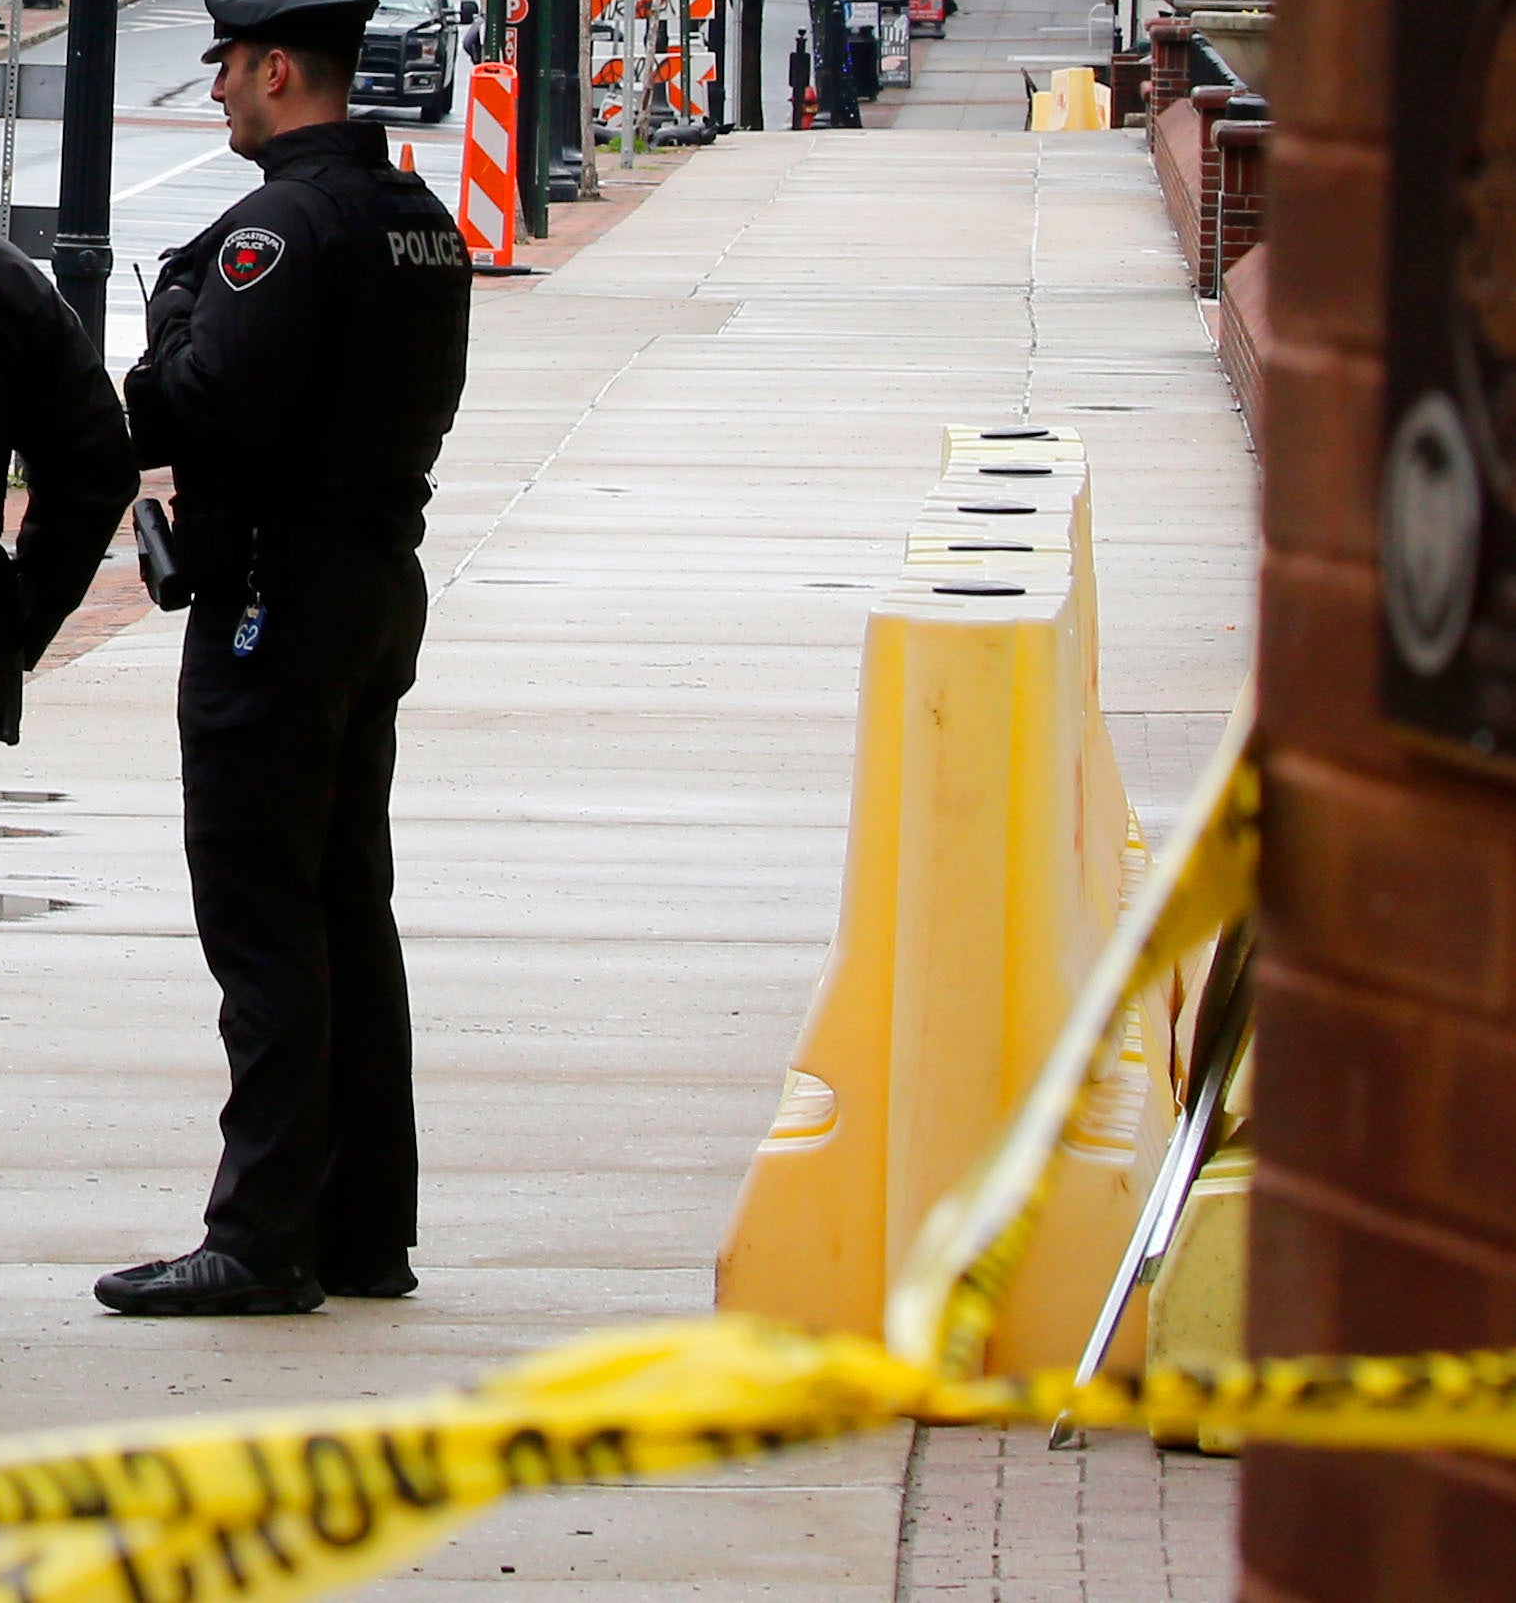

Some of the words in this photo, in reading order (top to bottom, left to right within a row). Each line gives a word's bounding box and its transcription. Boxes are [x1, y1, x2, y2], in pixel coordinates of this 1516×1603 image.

[236, 241, 264, 250] POLICE
[387, 231, 463, 266] POLICE
[234, 624, 258, 650] 62
